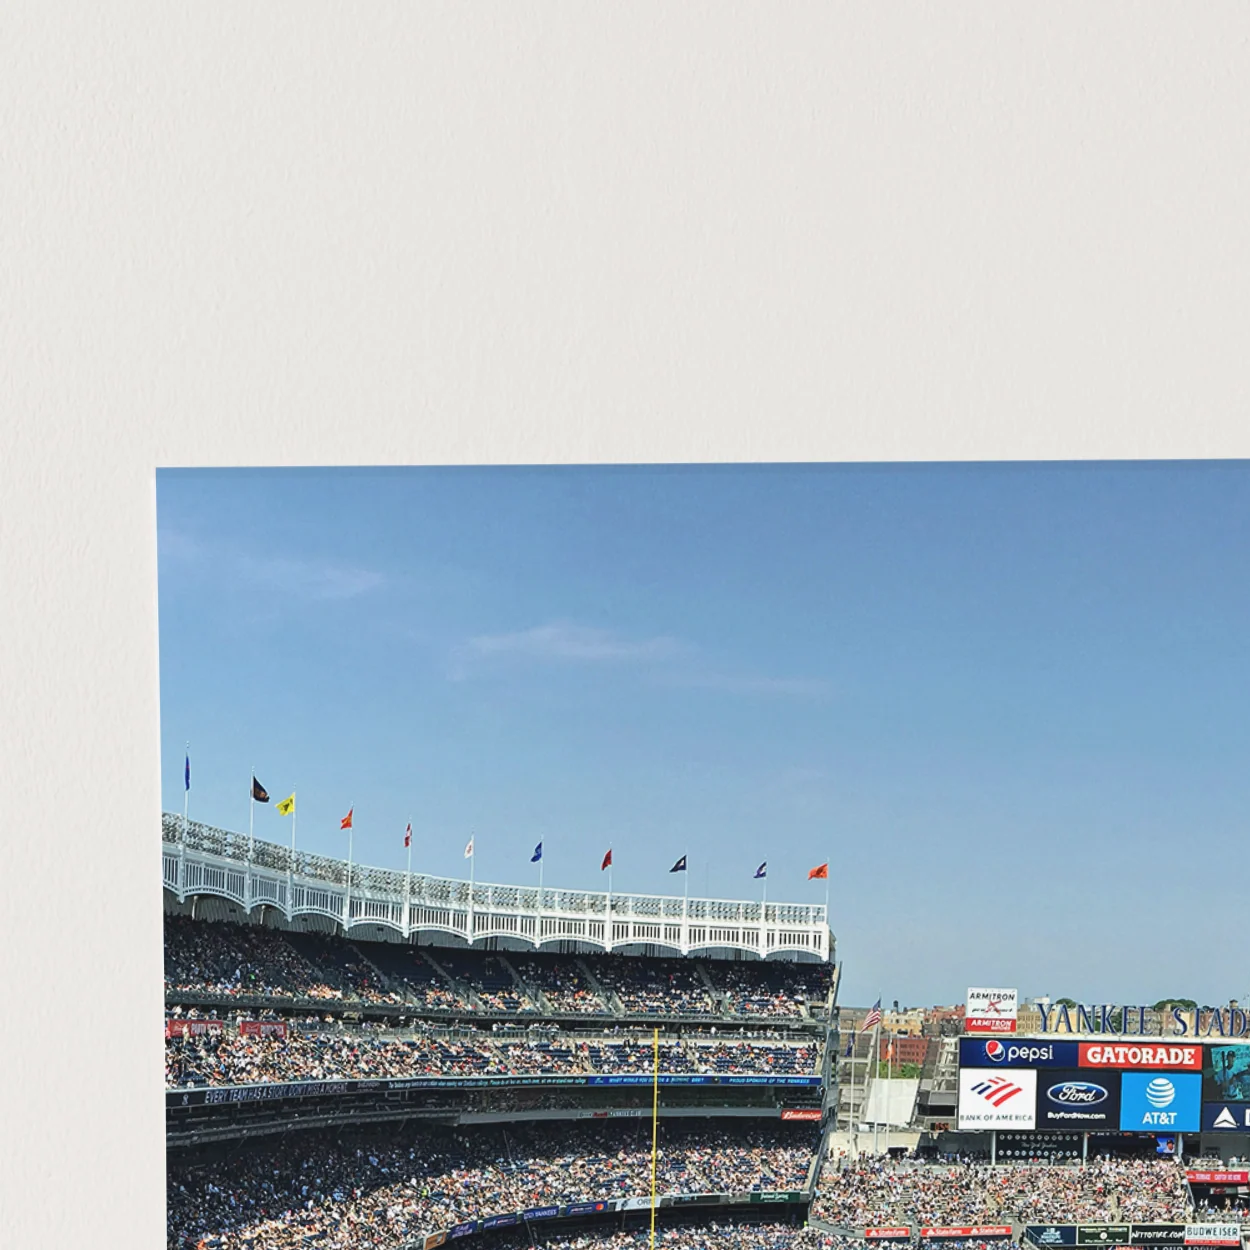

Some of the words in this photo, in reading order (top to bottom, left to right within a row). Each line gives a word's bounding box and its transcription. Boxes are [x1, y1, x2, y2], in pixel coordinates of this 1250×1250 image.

[1036, 1003, 1154, 1036] YANKEE
[1008, 1046, 1054, 1062] pepsi
[1087, 1048, 1195, 1065] GATORADE
[205, 1090, 228, 1104] EVERY
[229, 1089, 249, 1102] TEAM
[1058, 1085, 1096, 1102] Ford
[960, 1114, 983, 1122] BANK
[984, 1114, 994, 1122] OF
[998, 1114, 1034, 1122] AMERICA
[1047, 1111, 1106, 1121] BuyFordNow.com
[1142, 1112, 1178, 1125] AT&T
[1187, 1227, 1239, 1237] BUDWEISER
